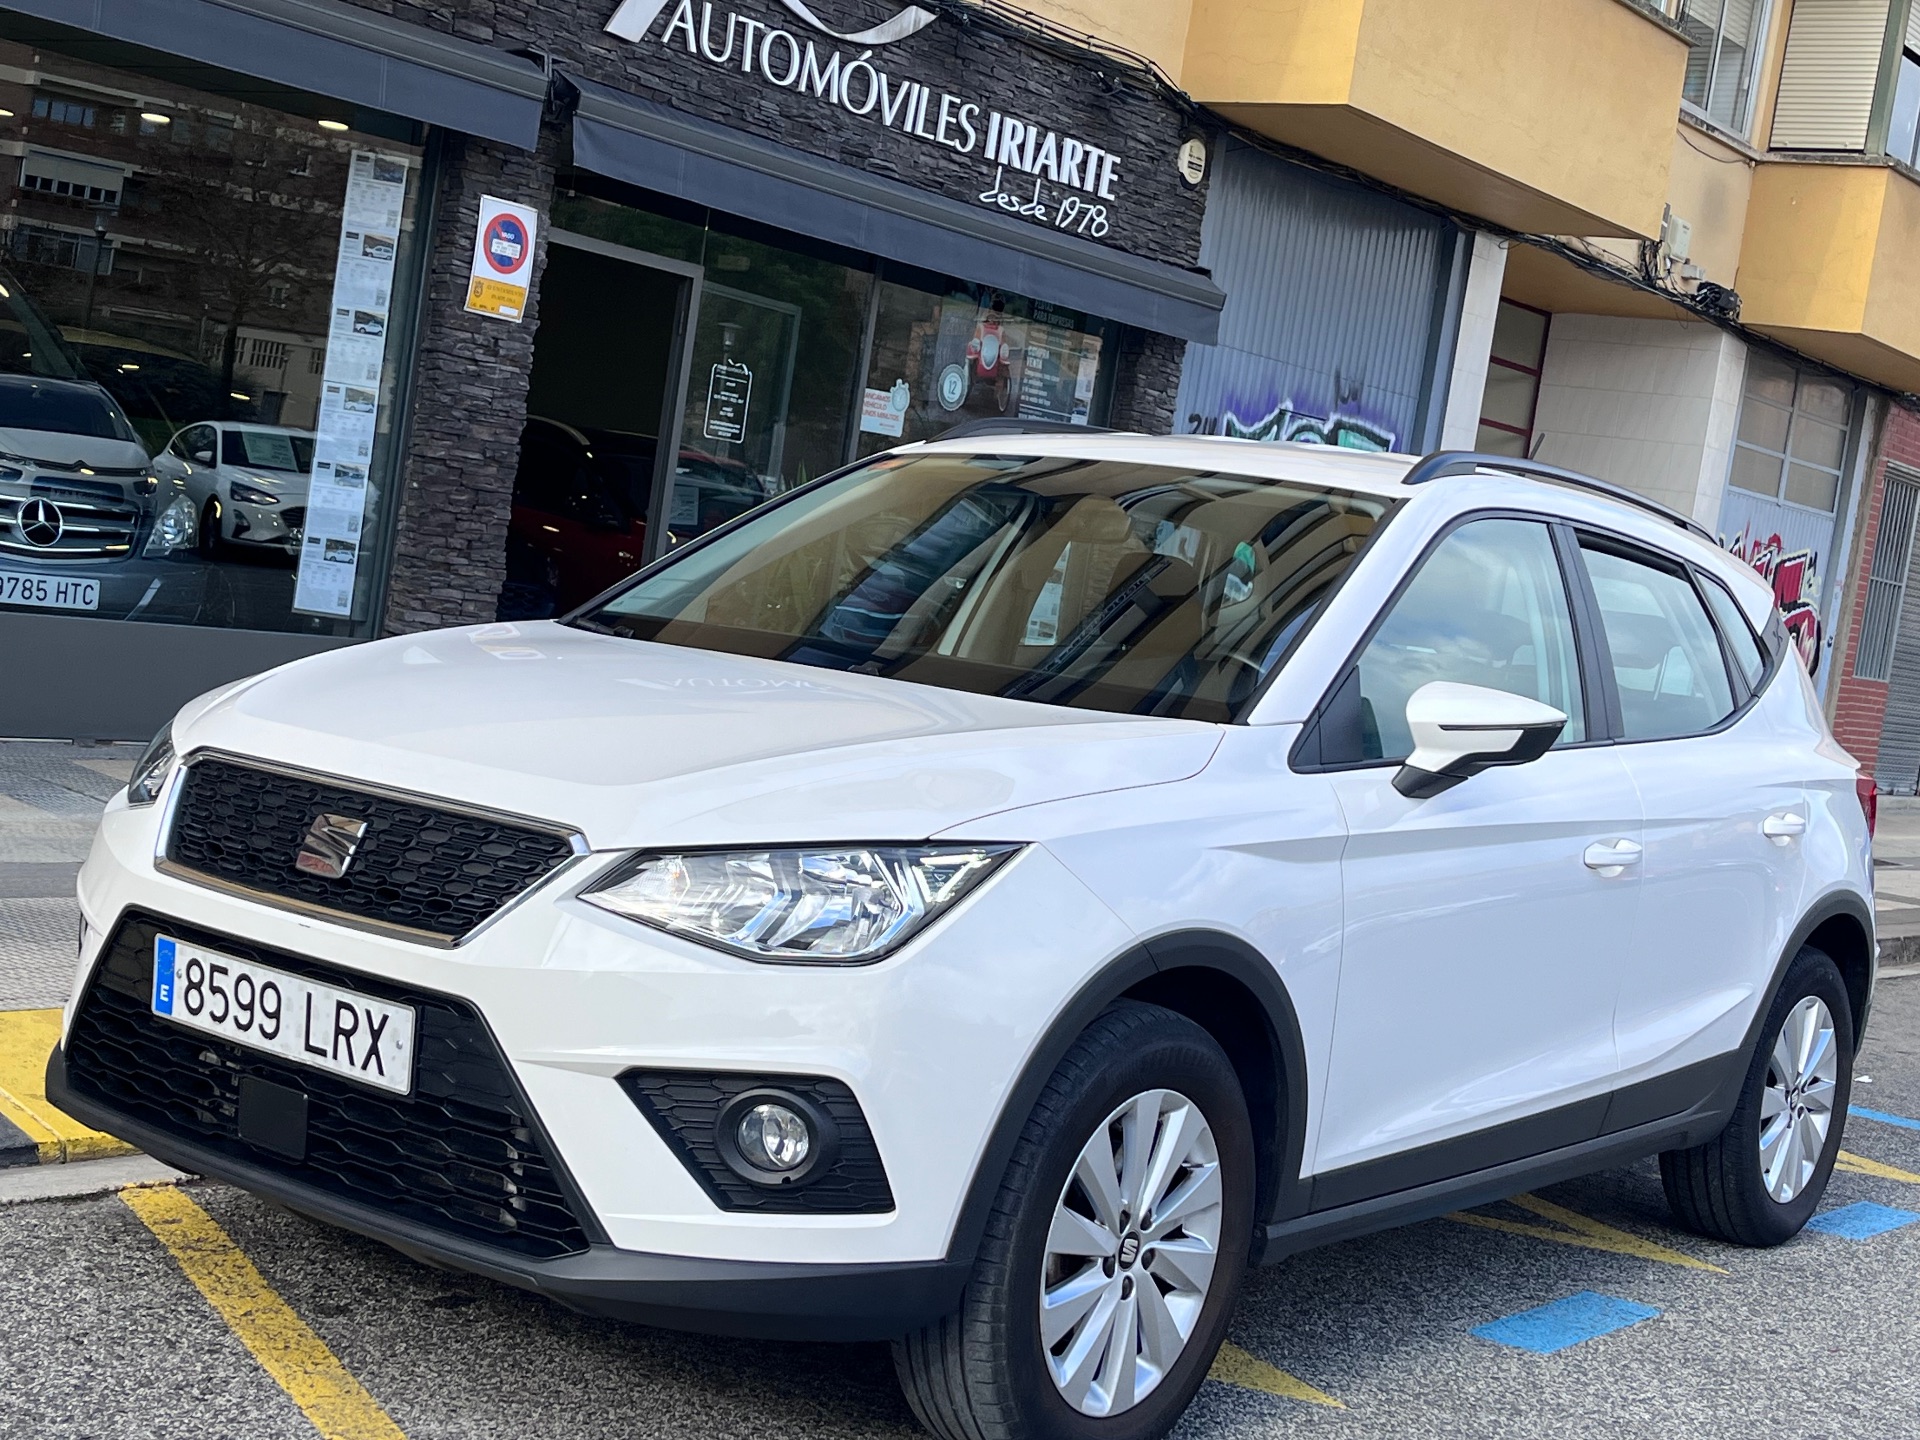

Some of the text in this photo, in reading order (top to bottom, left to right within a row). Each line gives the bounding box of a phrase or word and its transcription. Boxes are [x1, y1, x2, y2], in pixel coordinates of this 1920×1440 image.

[660, 0, 1121, 201] AUTOMÓVILES IRIARTE
[979, 166, 1109, 237] desde 1978
[948, 380, 957, 395] 12
[55, 581, 94, 606] HTC
[183, 957, 390, 1077] 8599 LRX
